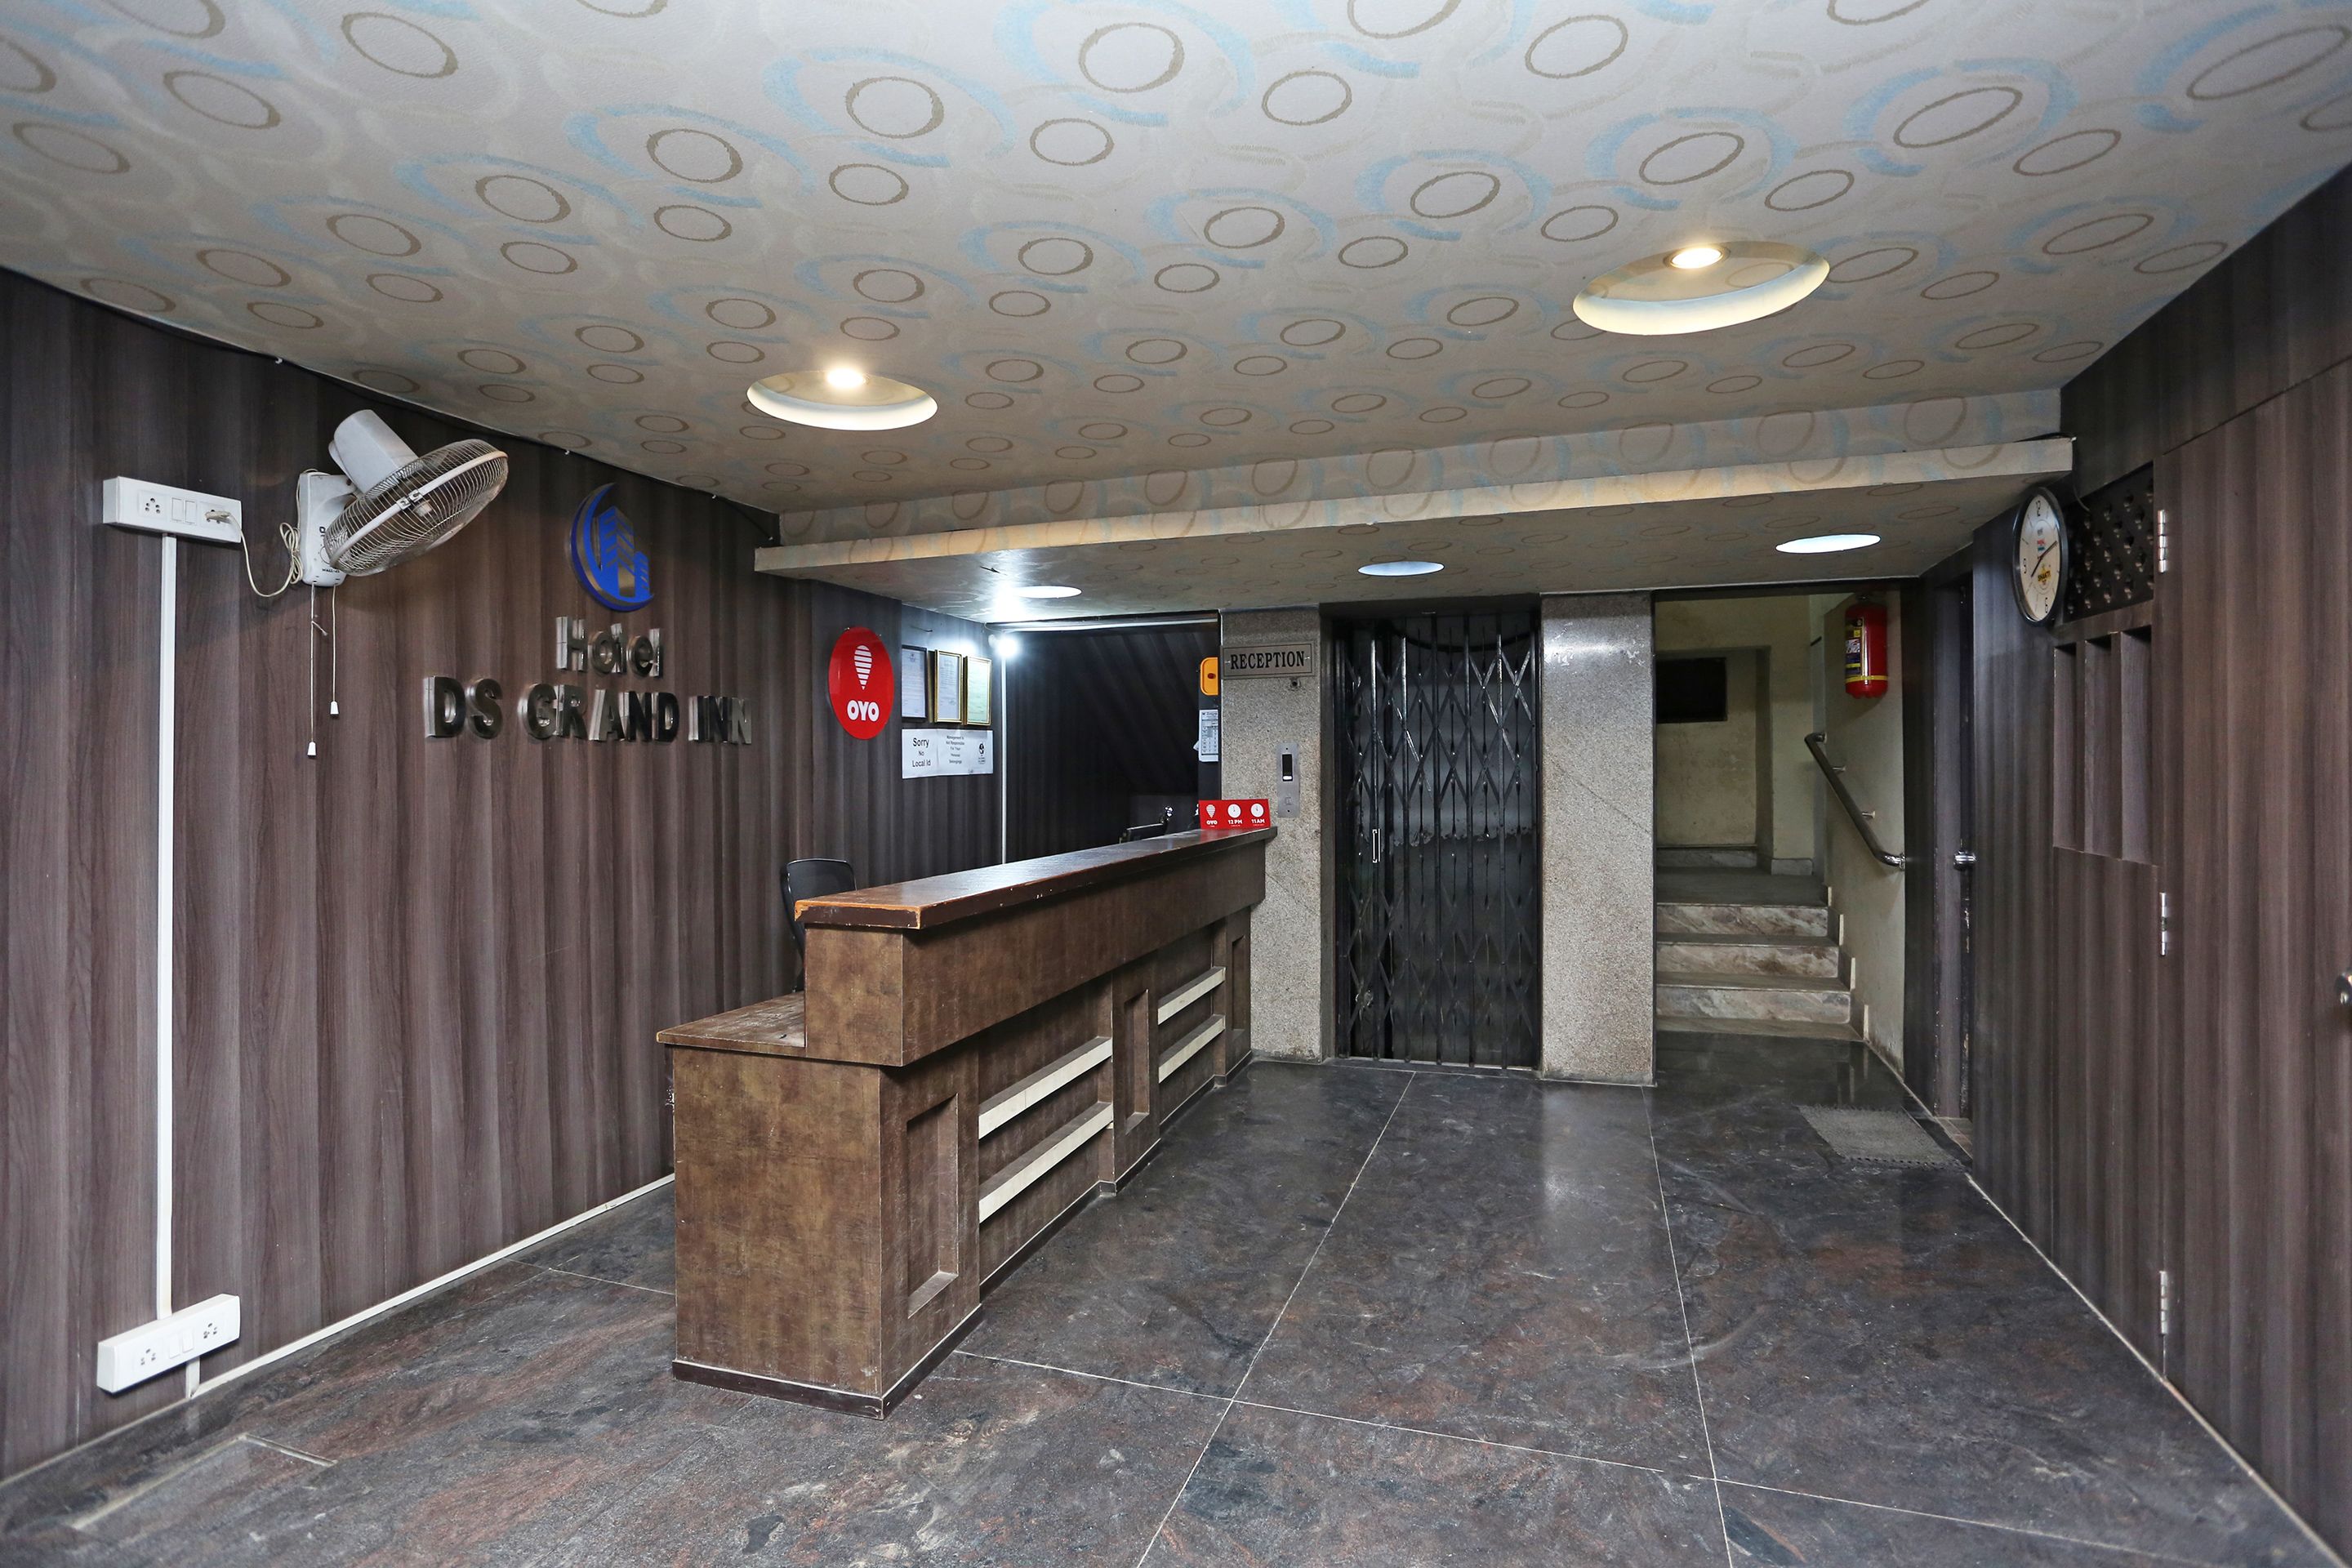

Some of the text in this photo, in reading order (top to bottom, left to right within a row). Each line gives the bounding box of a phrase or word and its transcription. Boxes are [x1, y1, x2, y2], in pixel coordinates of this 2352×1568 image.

[555, 616, 662, 678] Hotel
[1230, 650, 1305, 670] RECEPTION
[423, 675, 752, 745] DS GRAND INN
[847, 700, 880, 722] OYO
[912, 737, 929, 748] Sorry
